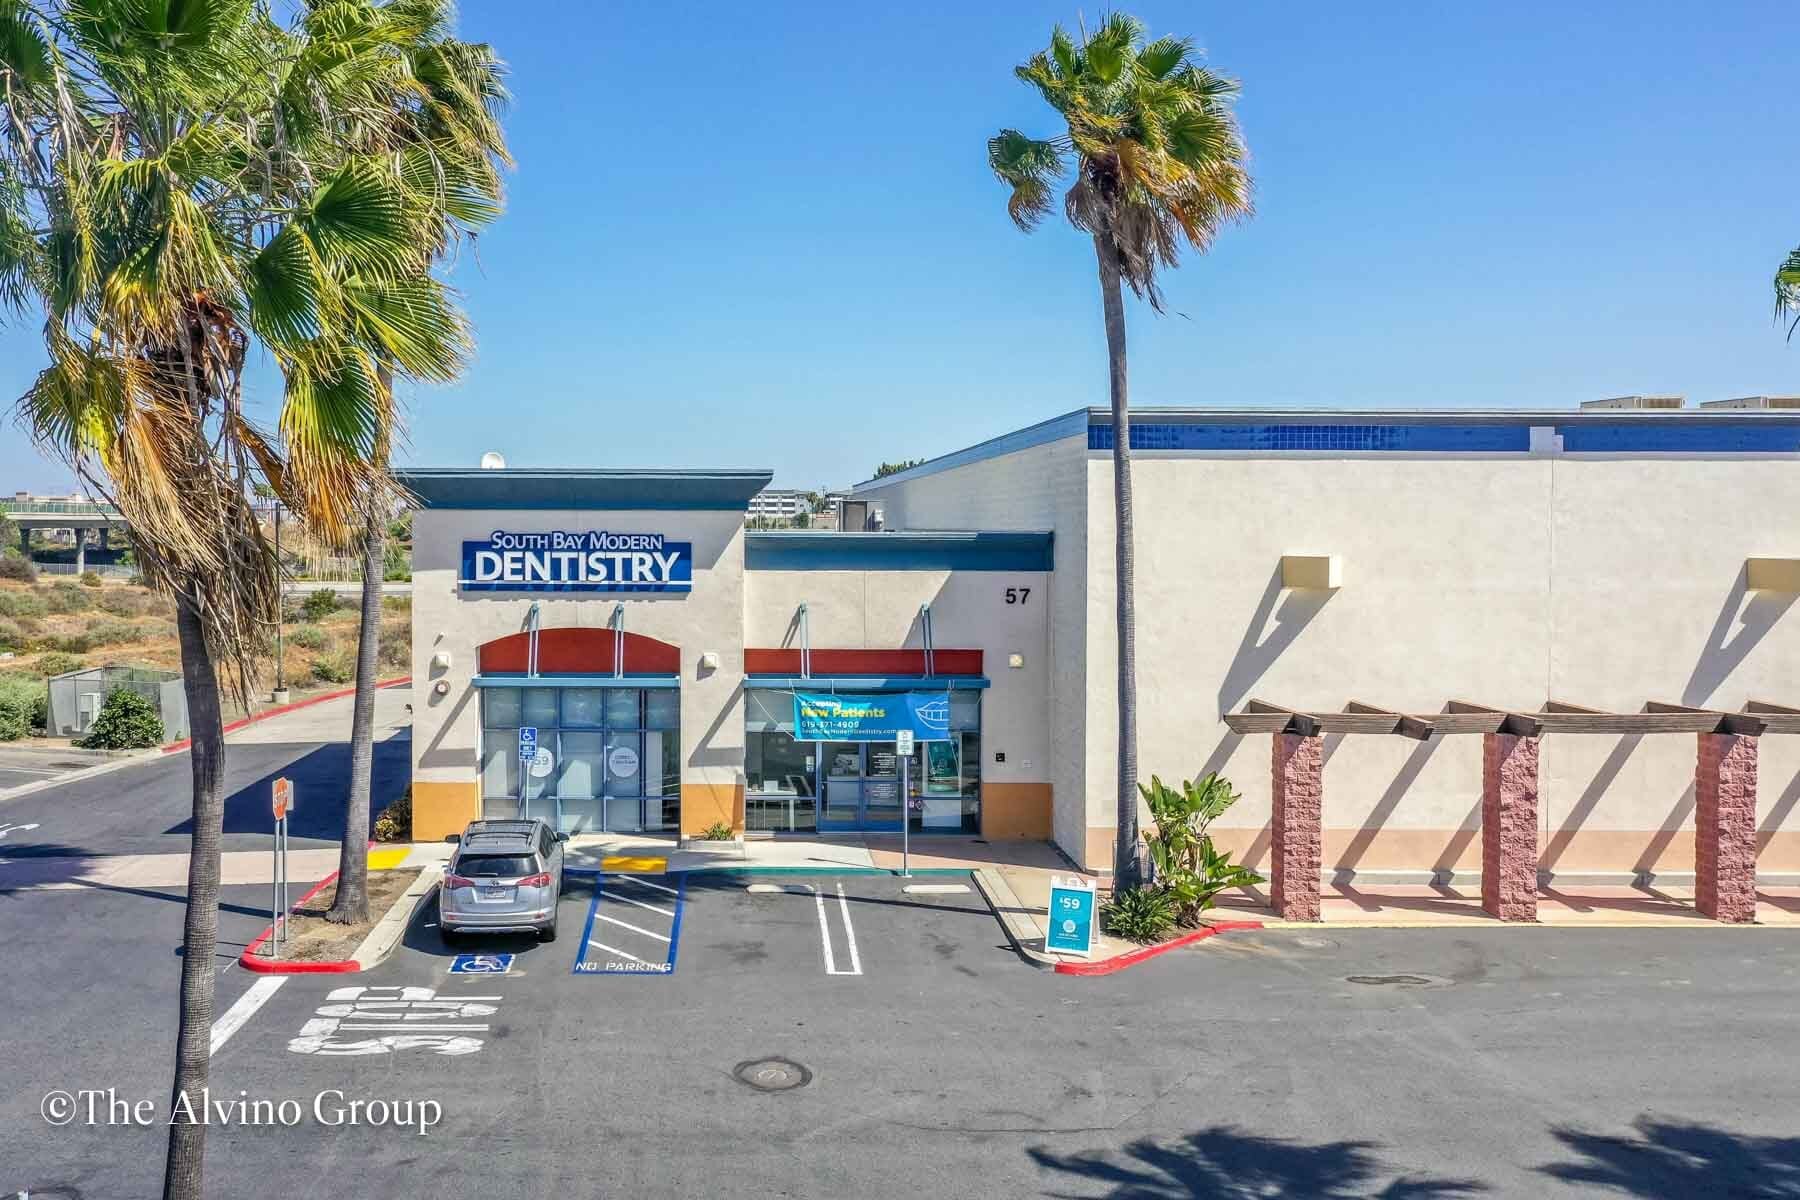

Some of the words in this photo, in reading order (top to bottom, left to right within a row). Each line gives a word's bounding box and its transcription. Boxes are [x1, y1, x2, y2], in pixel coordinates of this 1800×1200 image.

[475, 551, 681, 582] DENTISTRY
[1005, 588, 1031, 605] 57
[832, 708, 886, 718] Patients
[575, 962, 597, 970] NO
[606, 962, 672, 971] PARKING
